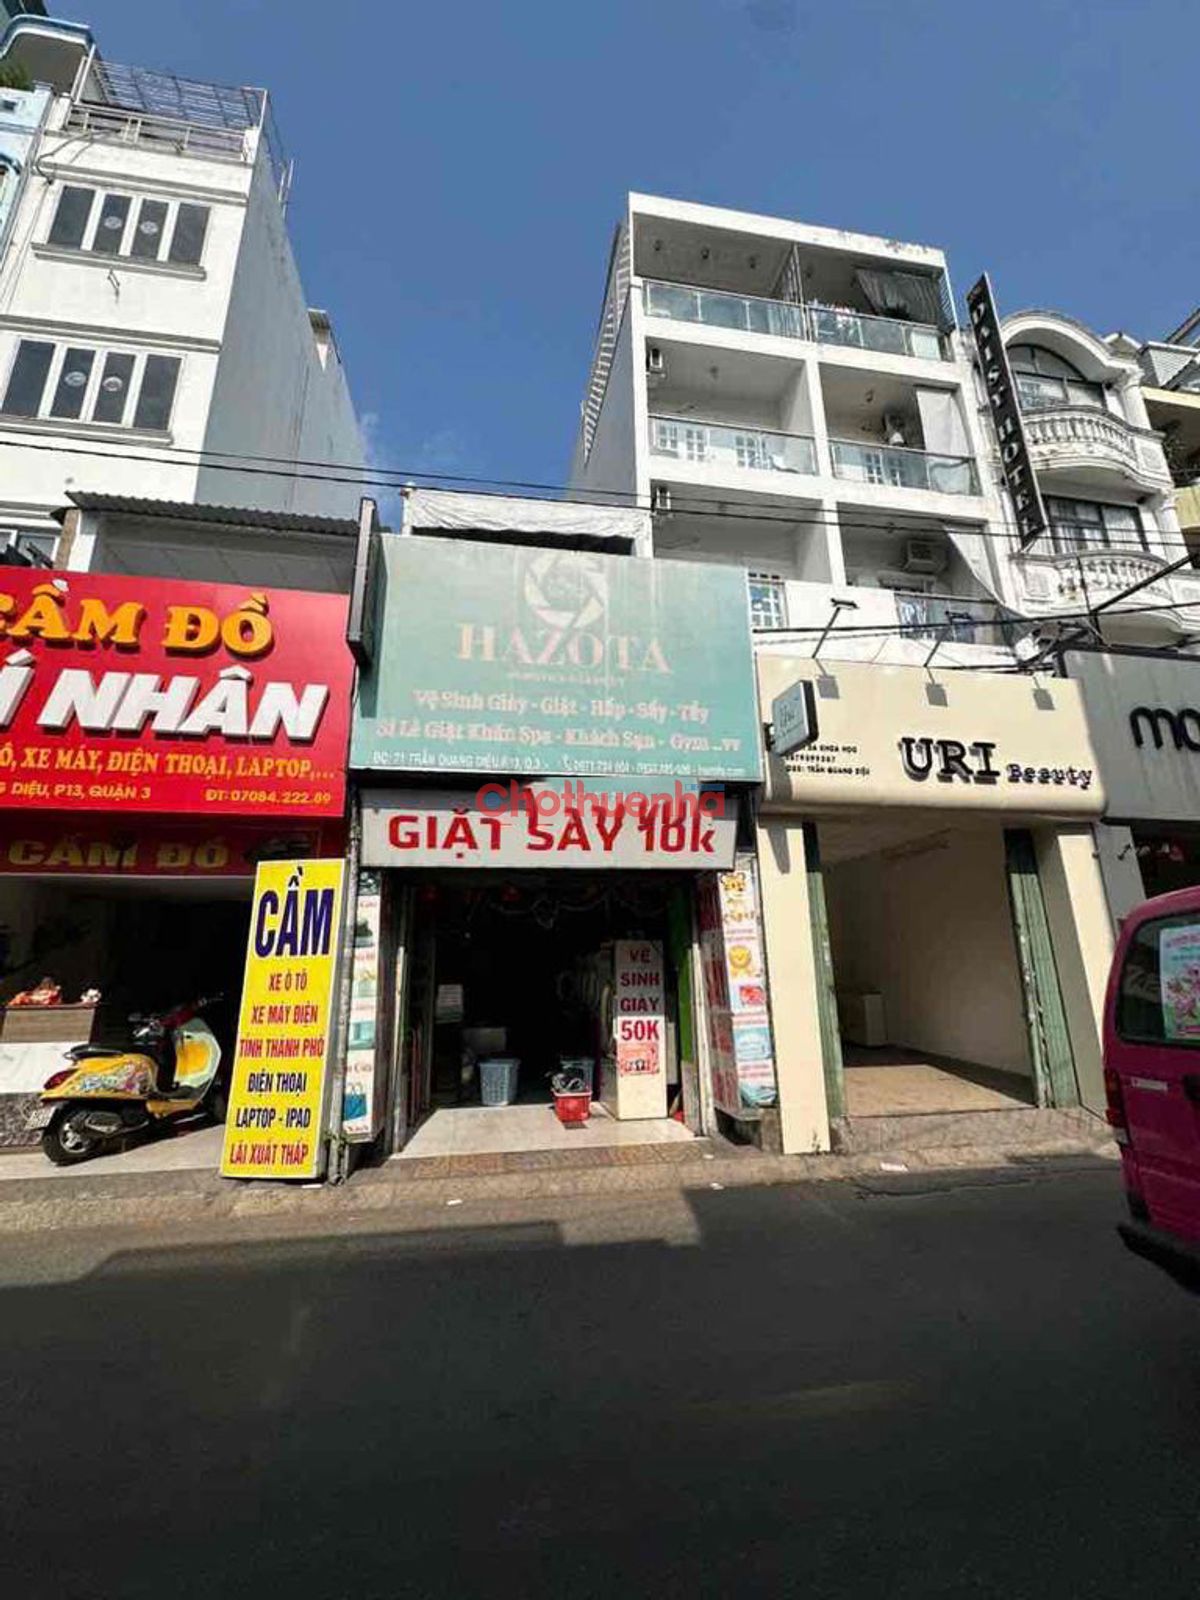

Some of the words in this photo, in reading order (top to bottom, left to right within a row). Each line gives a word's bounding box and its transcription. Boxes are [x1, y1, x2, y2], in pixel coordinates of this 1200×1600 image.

[999, 417, 1038, 537] HOTEL
[161, 591, 273, 654] ĐỒ
[457, 622, 674, 676] HAZOTA
[36, 664, 329, 738] NHÂN
[20, 747, 51, 769] XE
[54, 744, 103, 775] MÁY,
[106, 748, 160, 777] ĐIỆN
[165, 752, 232, 780] THOẠI,
[899, 737, 1000, 783] URI
[1006, 763, 1093, 790] Beauty
[12, 780, 50, 799] DIỆU,
[54, 783, 85, 799] P13,
[89, 782, 137, 801] QUẬN
[141, 786, 151, 799] 3
[388, 804, 501, 859] GIẶT
[255, 865, 336, 958] CẦM
[268, 972, 282, 992] XE
[295, 968, 308, 992] TÔ
[620, 971, 660, 988] SINH
[251, 1004, 266, 1025] XE
[268, 1001, 292, 1024] MÁY
[293, 1001, 319, 1028] ĐIỆN
[620, 1019, 660, 1041] 50K
[247, 1068, 274, 1098] ĐIỆN
[276, 1071, 308, 1097] THOẠI
[235, 1107, 277, 1128] LAPTOP
[285, 1107, 312, 1128] IPAD
